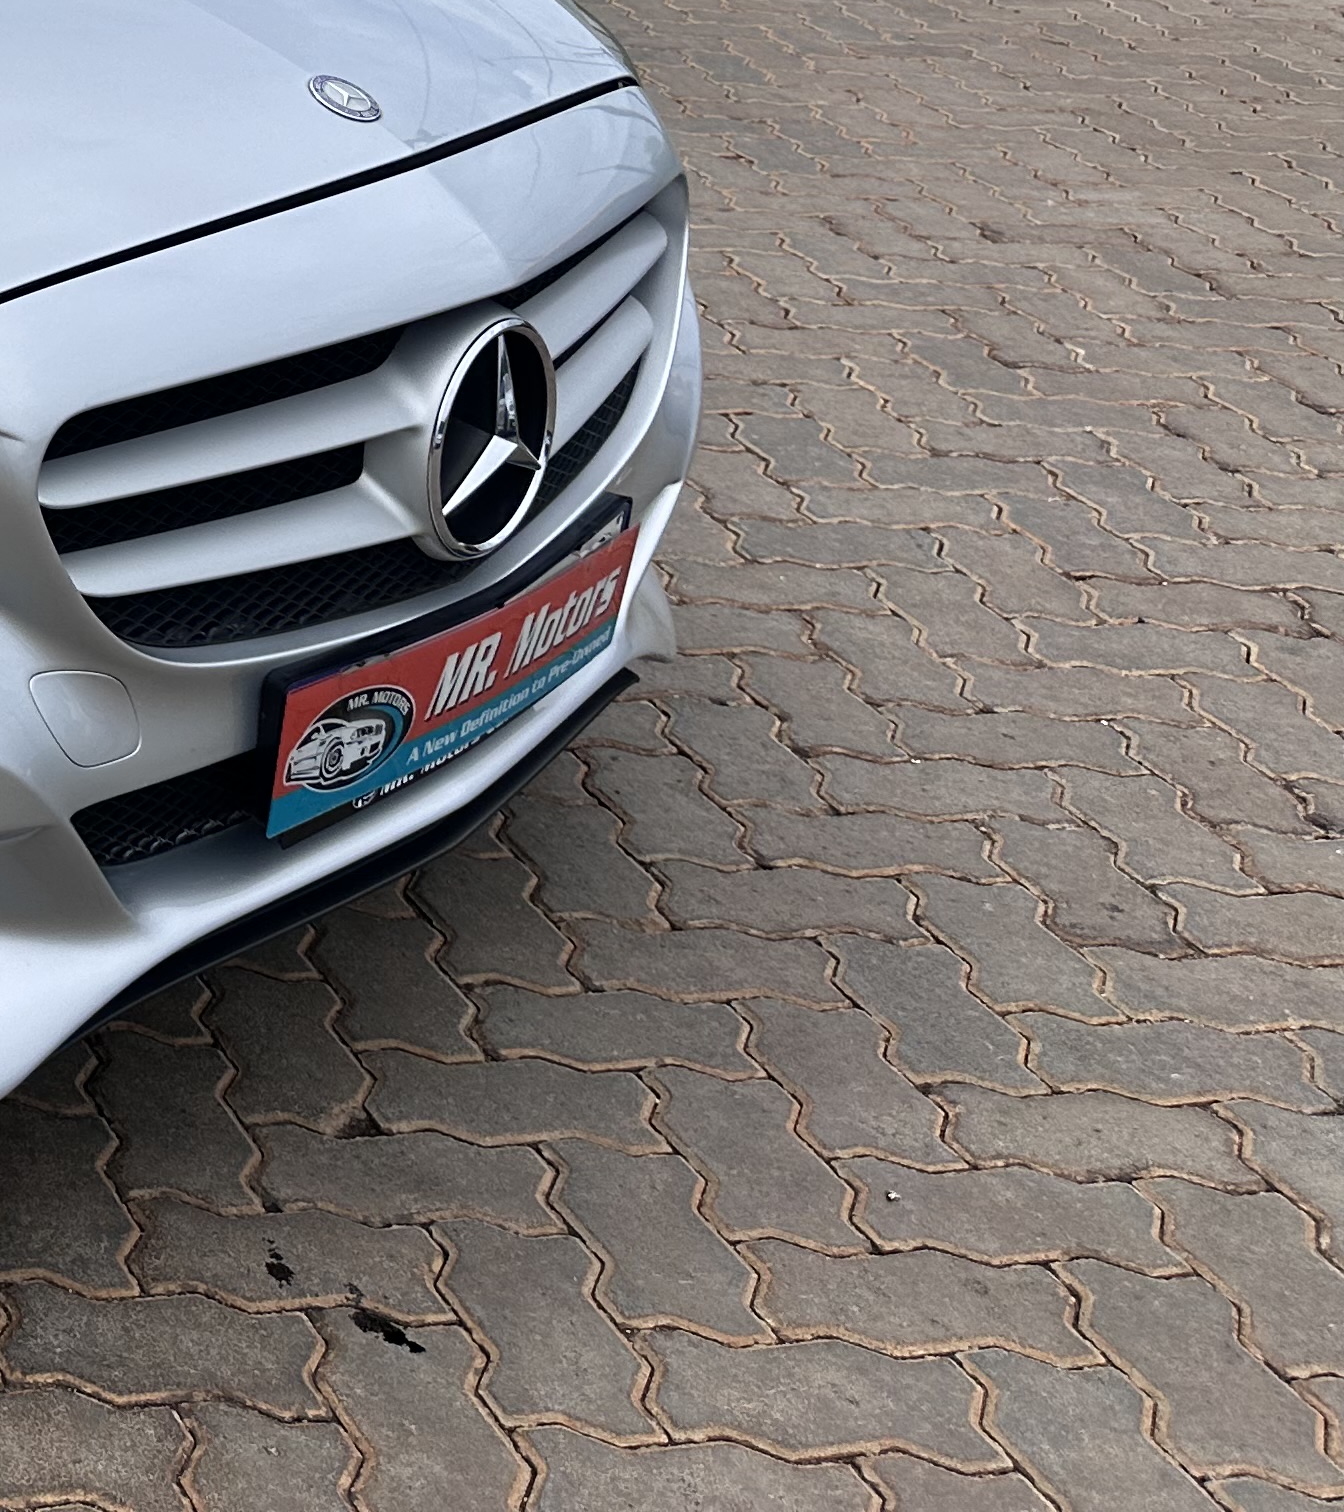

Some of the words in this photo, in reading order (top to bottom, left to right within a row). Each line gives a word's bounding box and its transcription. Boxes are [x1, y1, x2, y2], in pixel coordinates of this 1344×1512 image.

[346, 693, 370, 712] MR.
[372, 690, 411, 716] MOTORS
[406, 745, 419, 766] A
[423, 728, 456, 758] New
[461, 688, 529, 739] Definition
[531, 675, 546, 695] to
[548, 626, 612, 681] Pre-Owned
[423, 631, 502, 722] MR.
[503, 566, 622, 680] Motors
